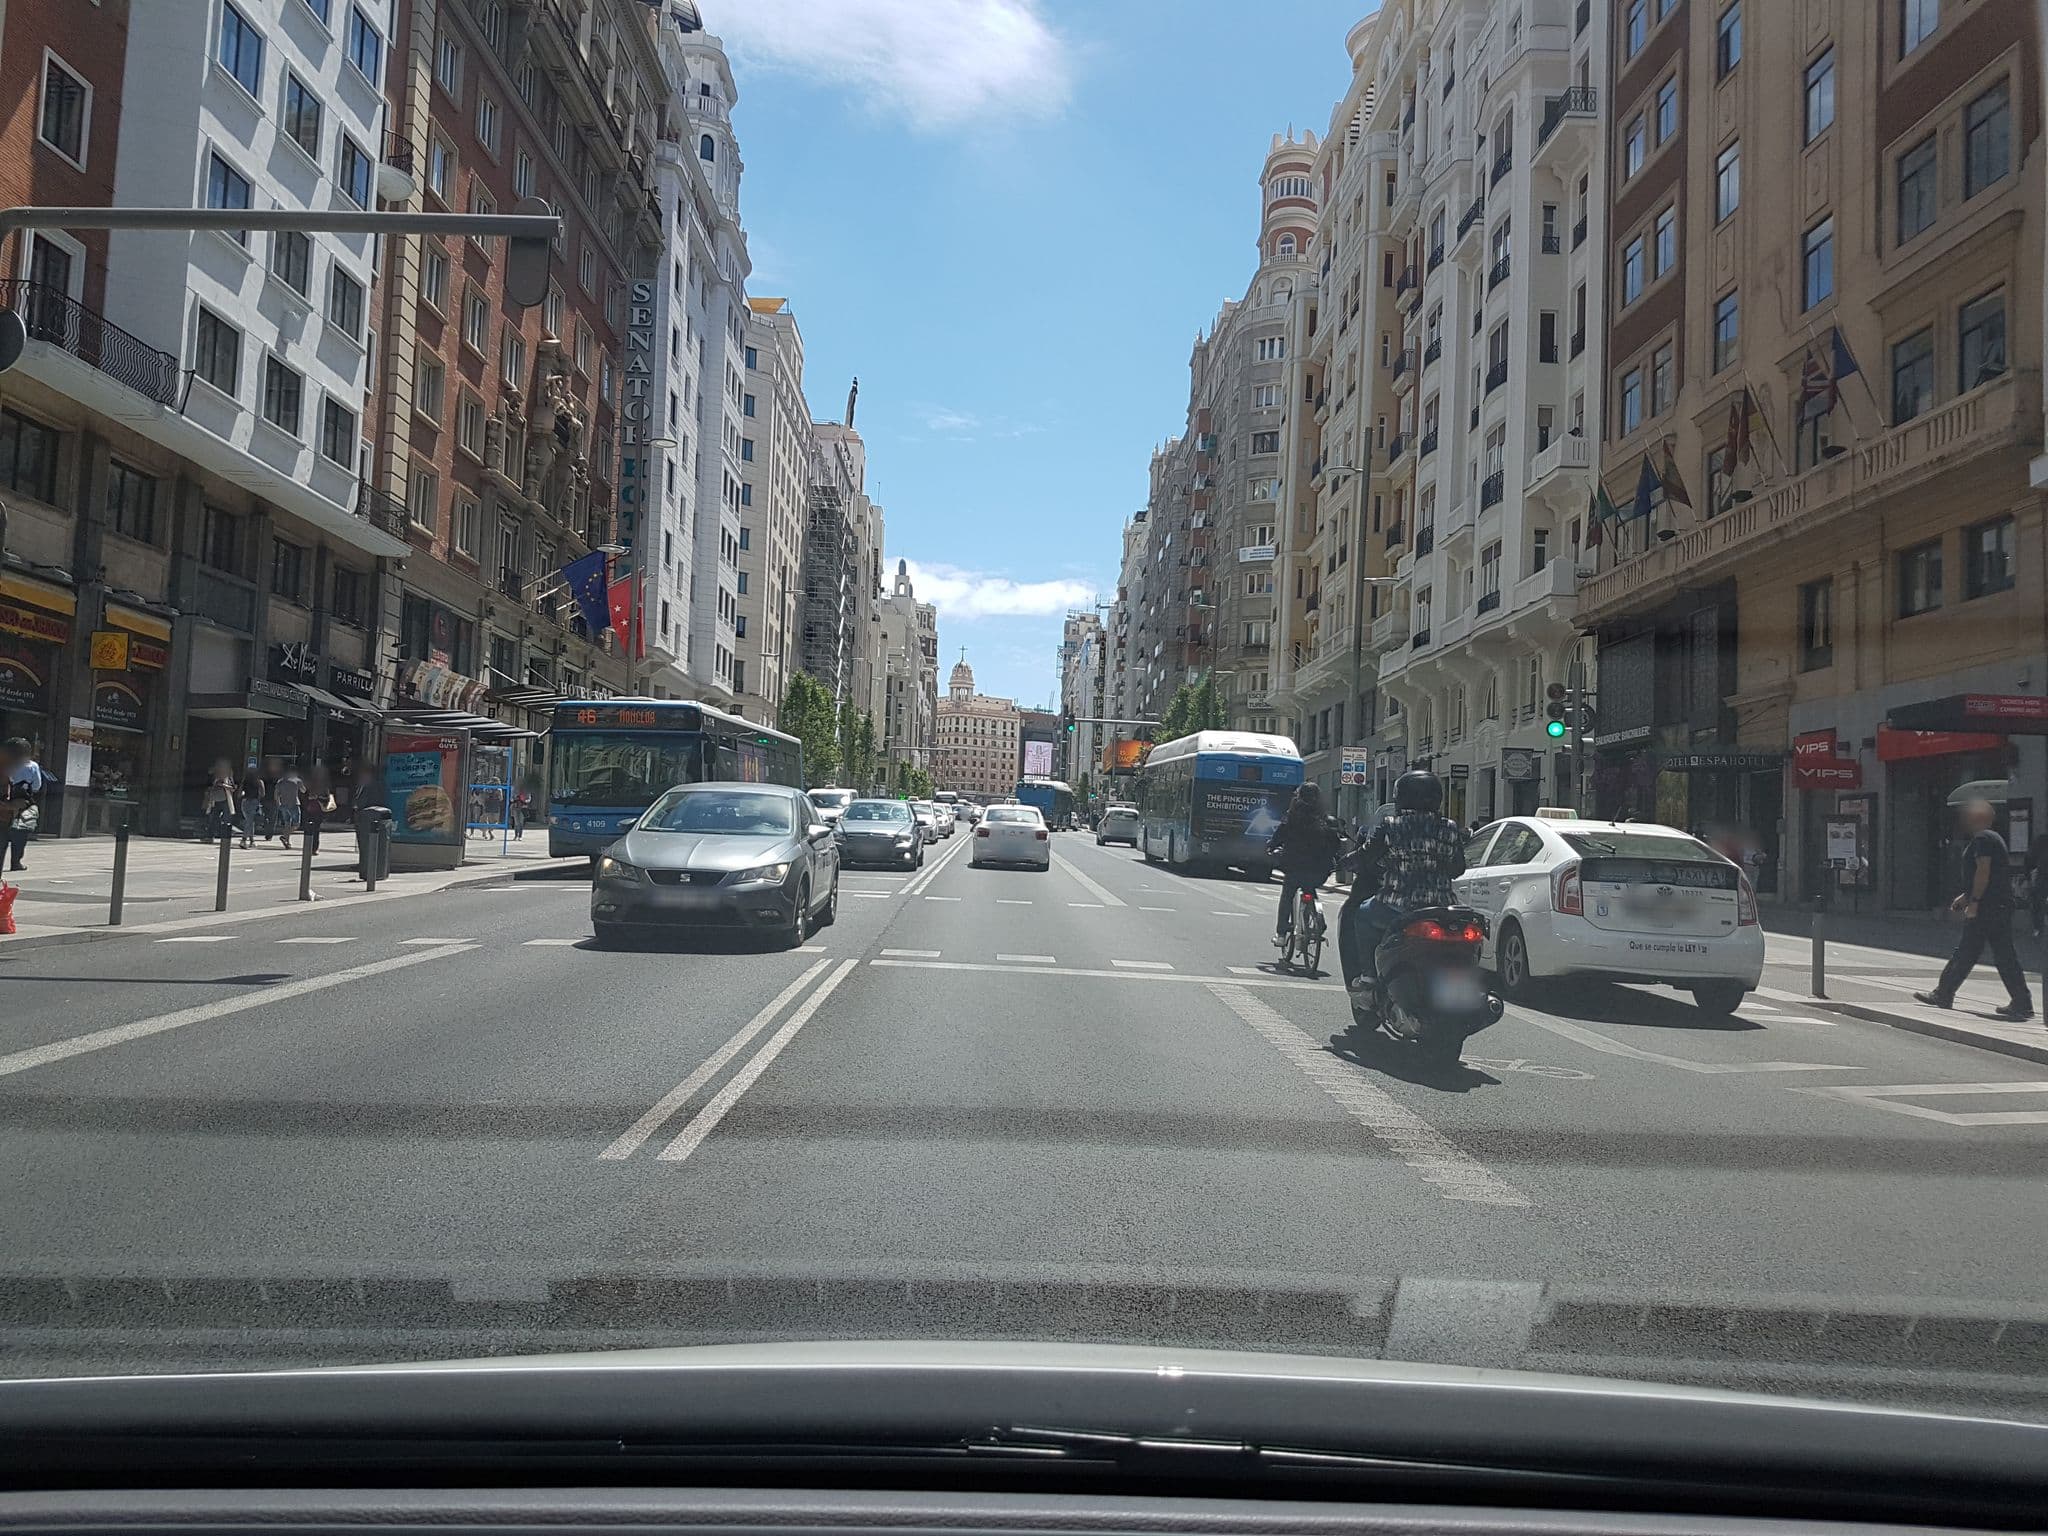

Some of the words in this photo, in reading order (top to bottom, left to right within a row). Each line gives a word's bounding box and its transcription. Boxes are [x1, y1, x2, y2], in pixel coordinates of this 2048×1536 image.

[624, 282, 653, 446] SENATOR
[336, 670, 374, 692] PARRILLA
[559, 681, 591, 700] HOTEL
[1795, 741, 1829, 754] VIPS
[1798, 767, 1855, 779] VIPS
[1206, 793, 1222, 802] THE
[1222, 795, 1241, 804] PINK
[1242, 797, 1267, 806] FLOYD
[1206, 801, 1250, 812] EXHIBITION
[586, 820, 606, 829] 4109
[1629, 940, 1643, 951] Que
[1685, 943, 1696, 953] LEY
